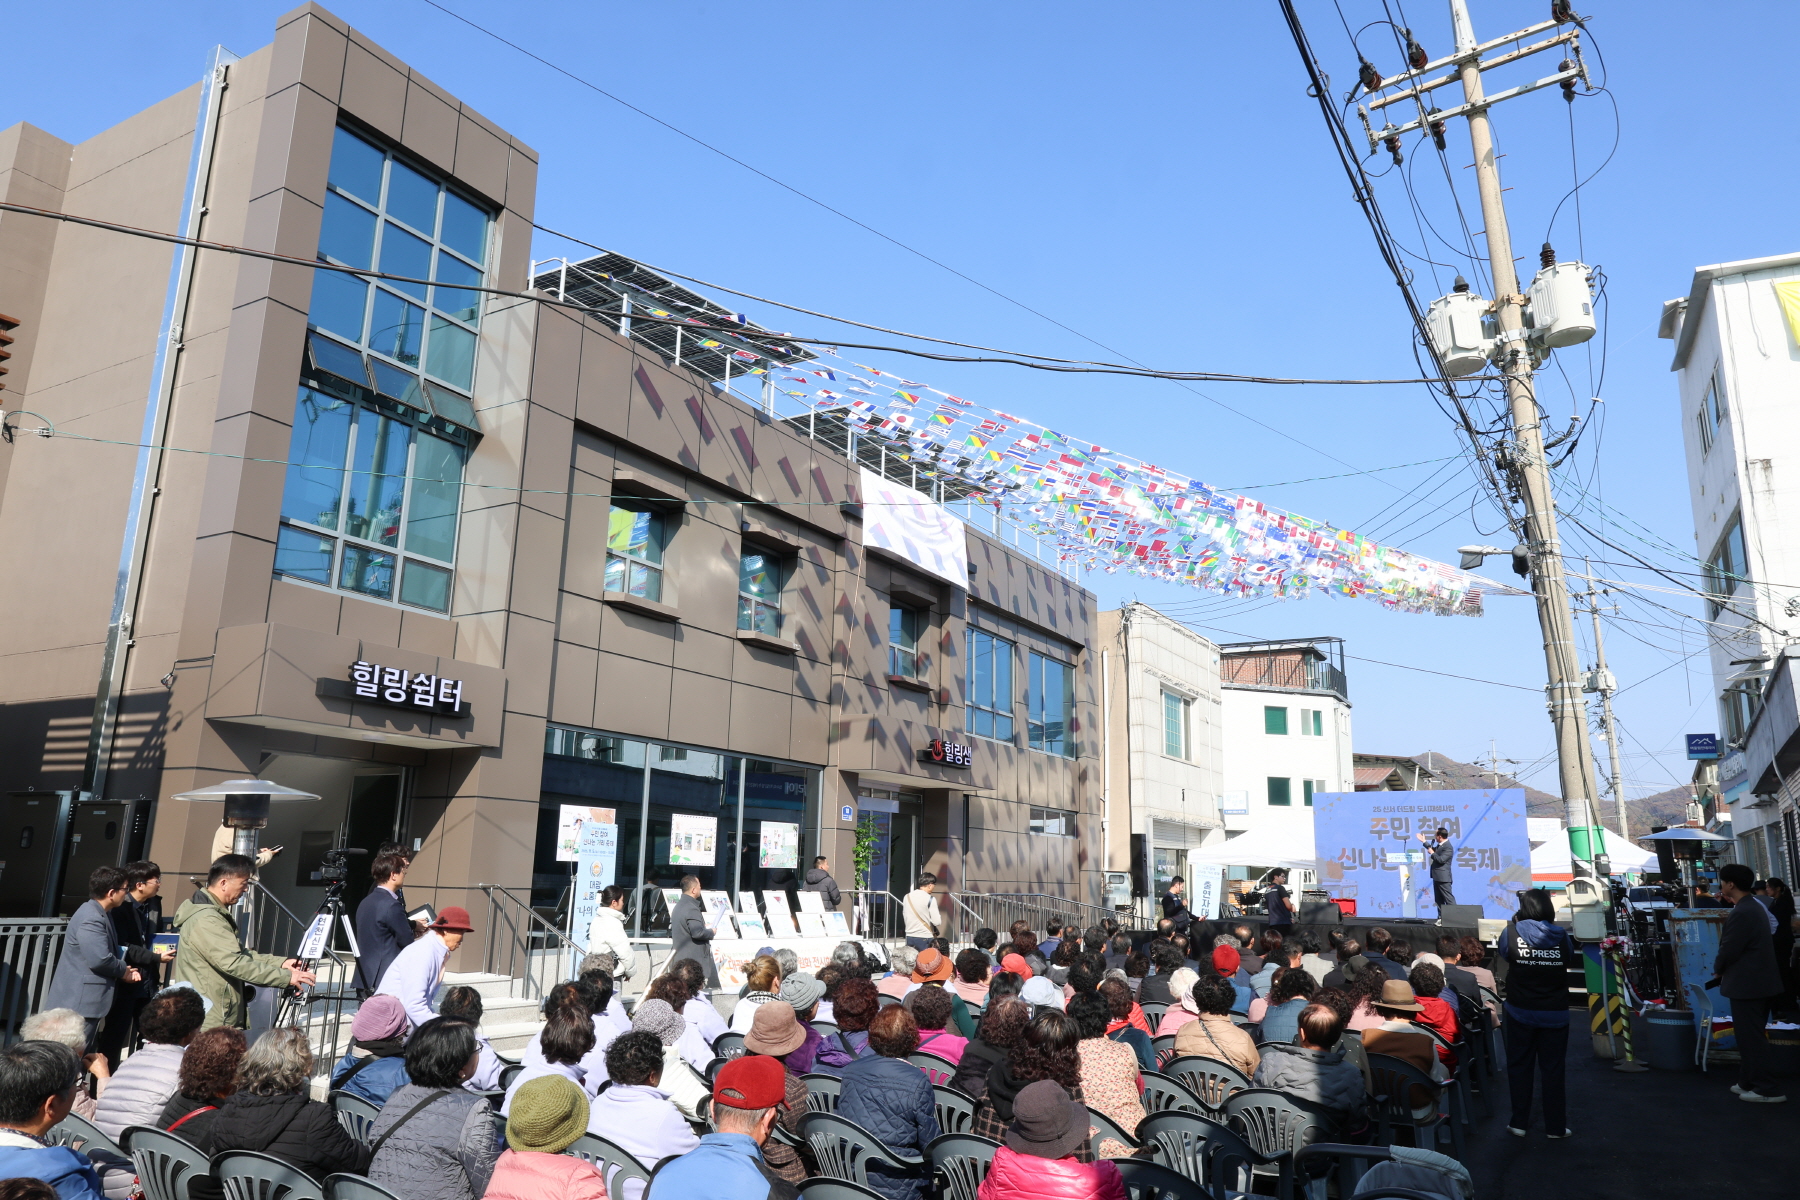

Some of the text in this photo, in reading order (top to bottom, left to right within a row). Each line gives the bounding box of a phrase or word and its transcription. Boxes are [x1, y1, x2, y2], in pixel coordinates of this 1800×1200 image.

[354, 660, 462, 712] 힐링쉼터
[945, 741, 972, 766] 힐링샘
[1383, 805, 1396, 813] 신서
[1417, 805, 1455, 813] 도시재생사업
[1369, 816, 1461, 841] 주민 참여
[1337, 847, 1399, 871] 신나는
[1456, 846, 1500, 871] 축제
[589, 880, 602, 889] 대광
[309, 917, 327, 956] 연천신문
[1517, 948, 1561, 959] YC PRESS
